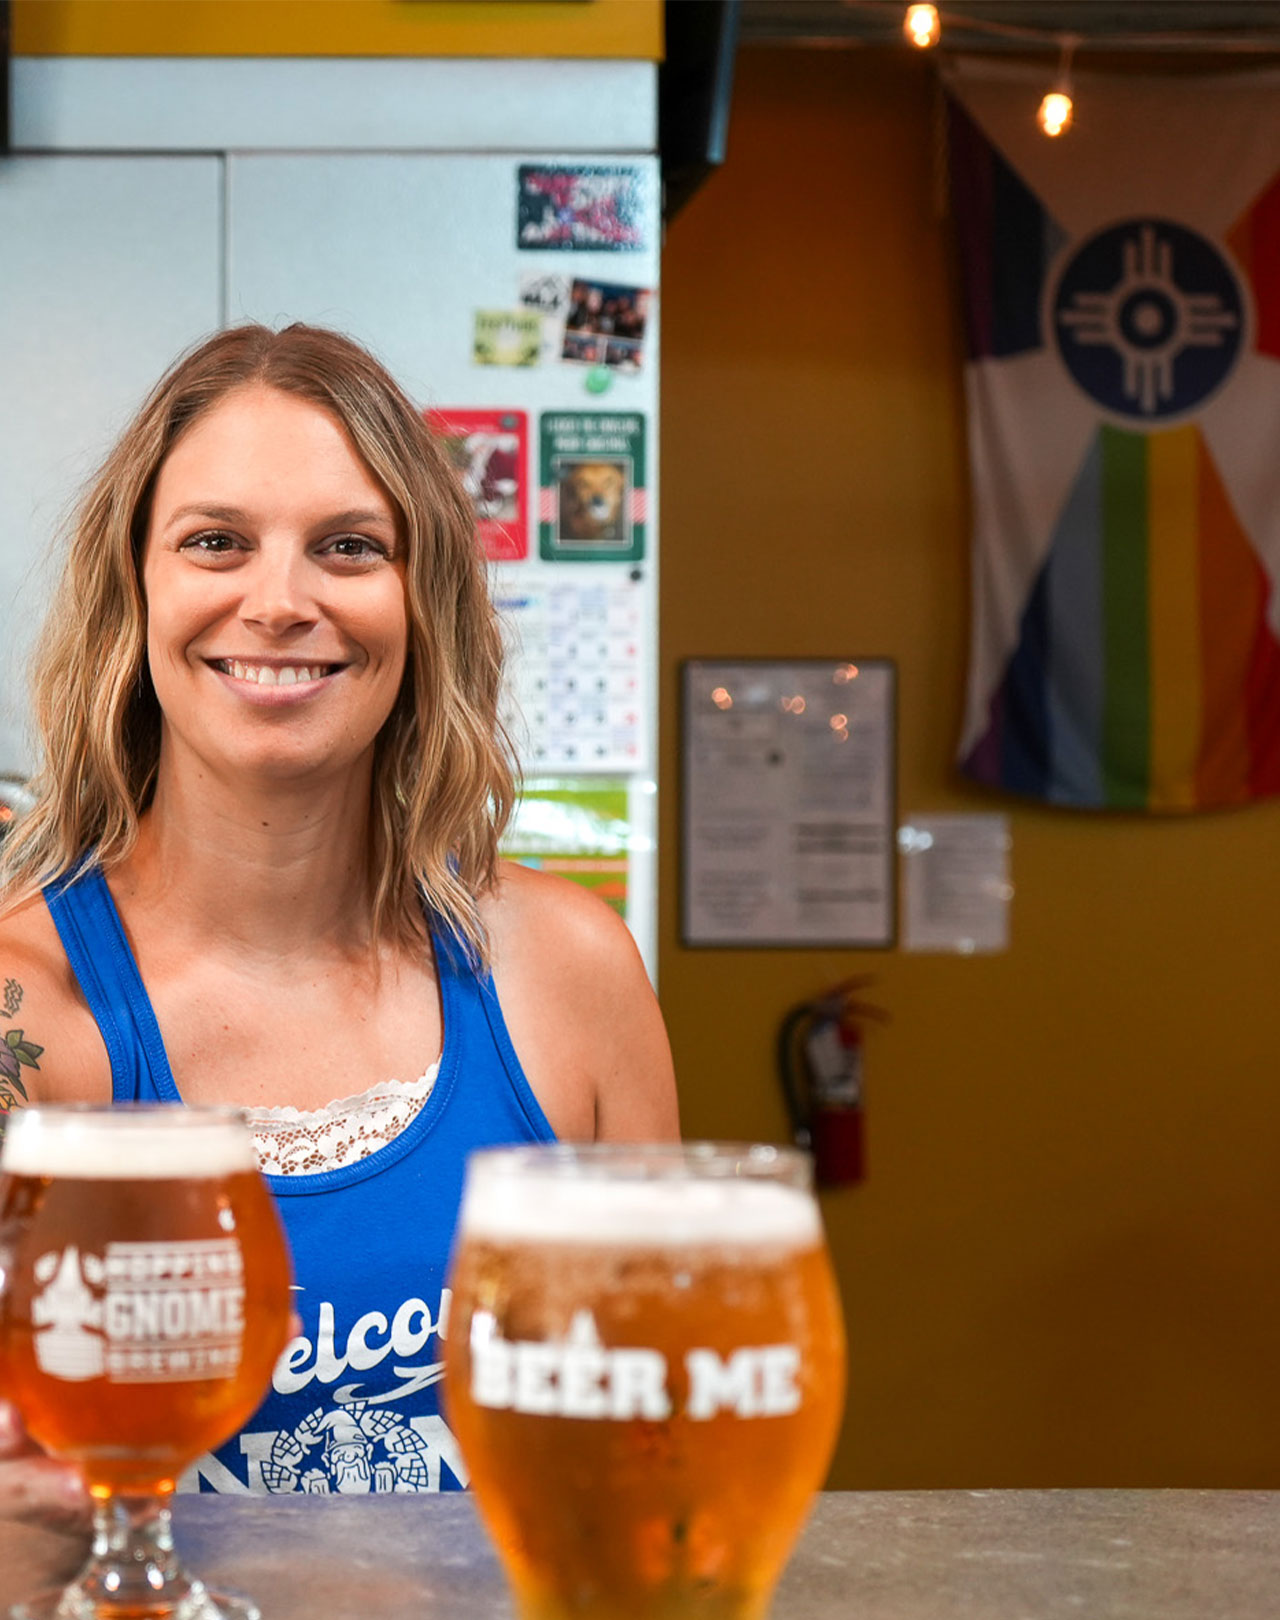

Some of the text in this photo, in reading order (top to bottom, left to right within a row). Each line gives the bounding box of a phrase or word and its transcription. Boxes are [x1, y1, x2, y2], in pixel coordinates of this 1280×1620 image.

[106, 1288, 245, 1341] GNOME
[272, 1285, 453, 1394] elco
[471, 1339, 803, 1422] BEER ME
